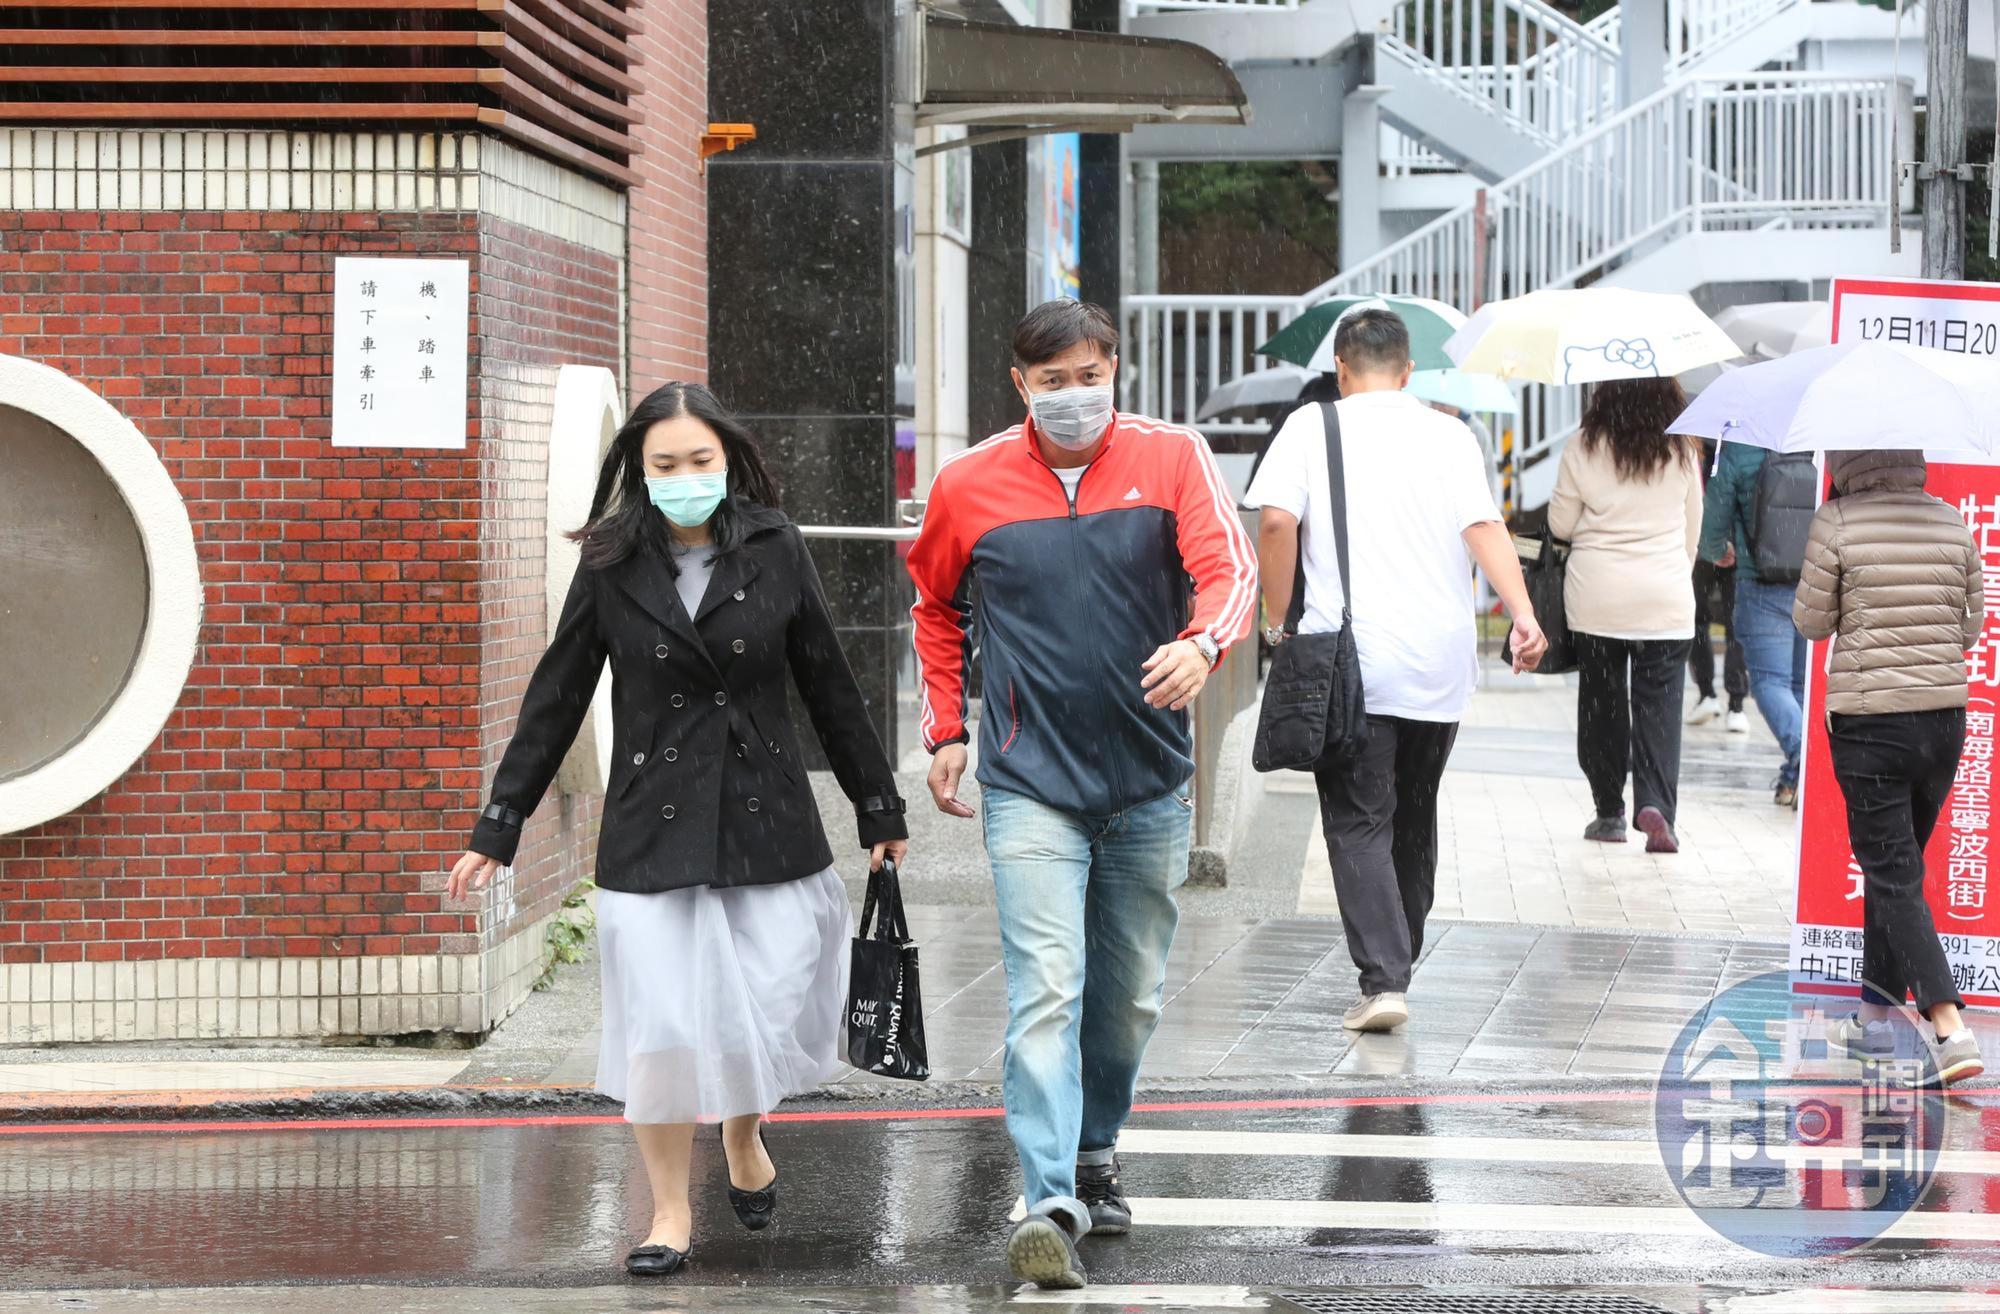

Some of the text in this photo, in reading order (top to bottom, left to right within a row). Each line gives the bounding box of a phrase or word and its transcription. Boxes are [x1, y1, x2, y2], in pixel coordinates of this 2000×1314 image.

[359, 280, 378, 411] 請下車牽引
[418, 280, 437, 383] 機、踏車
